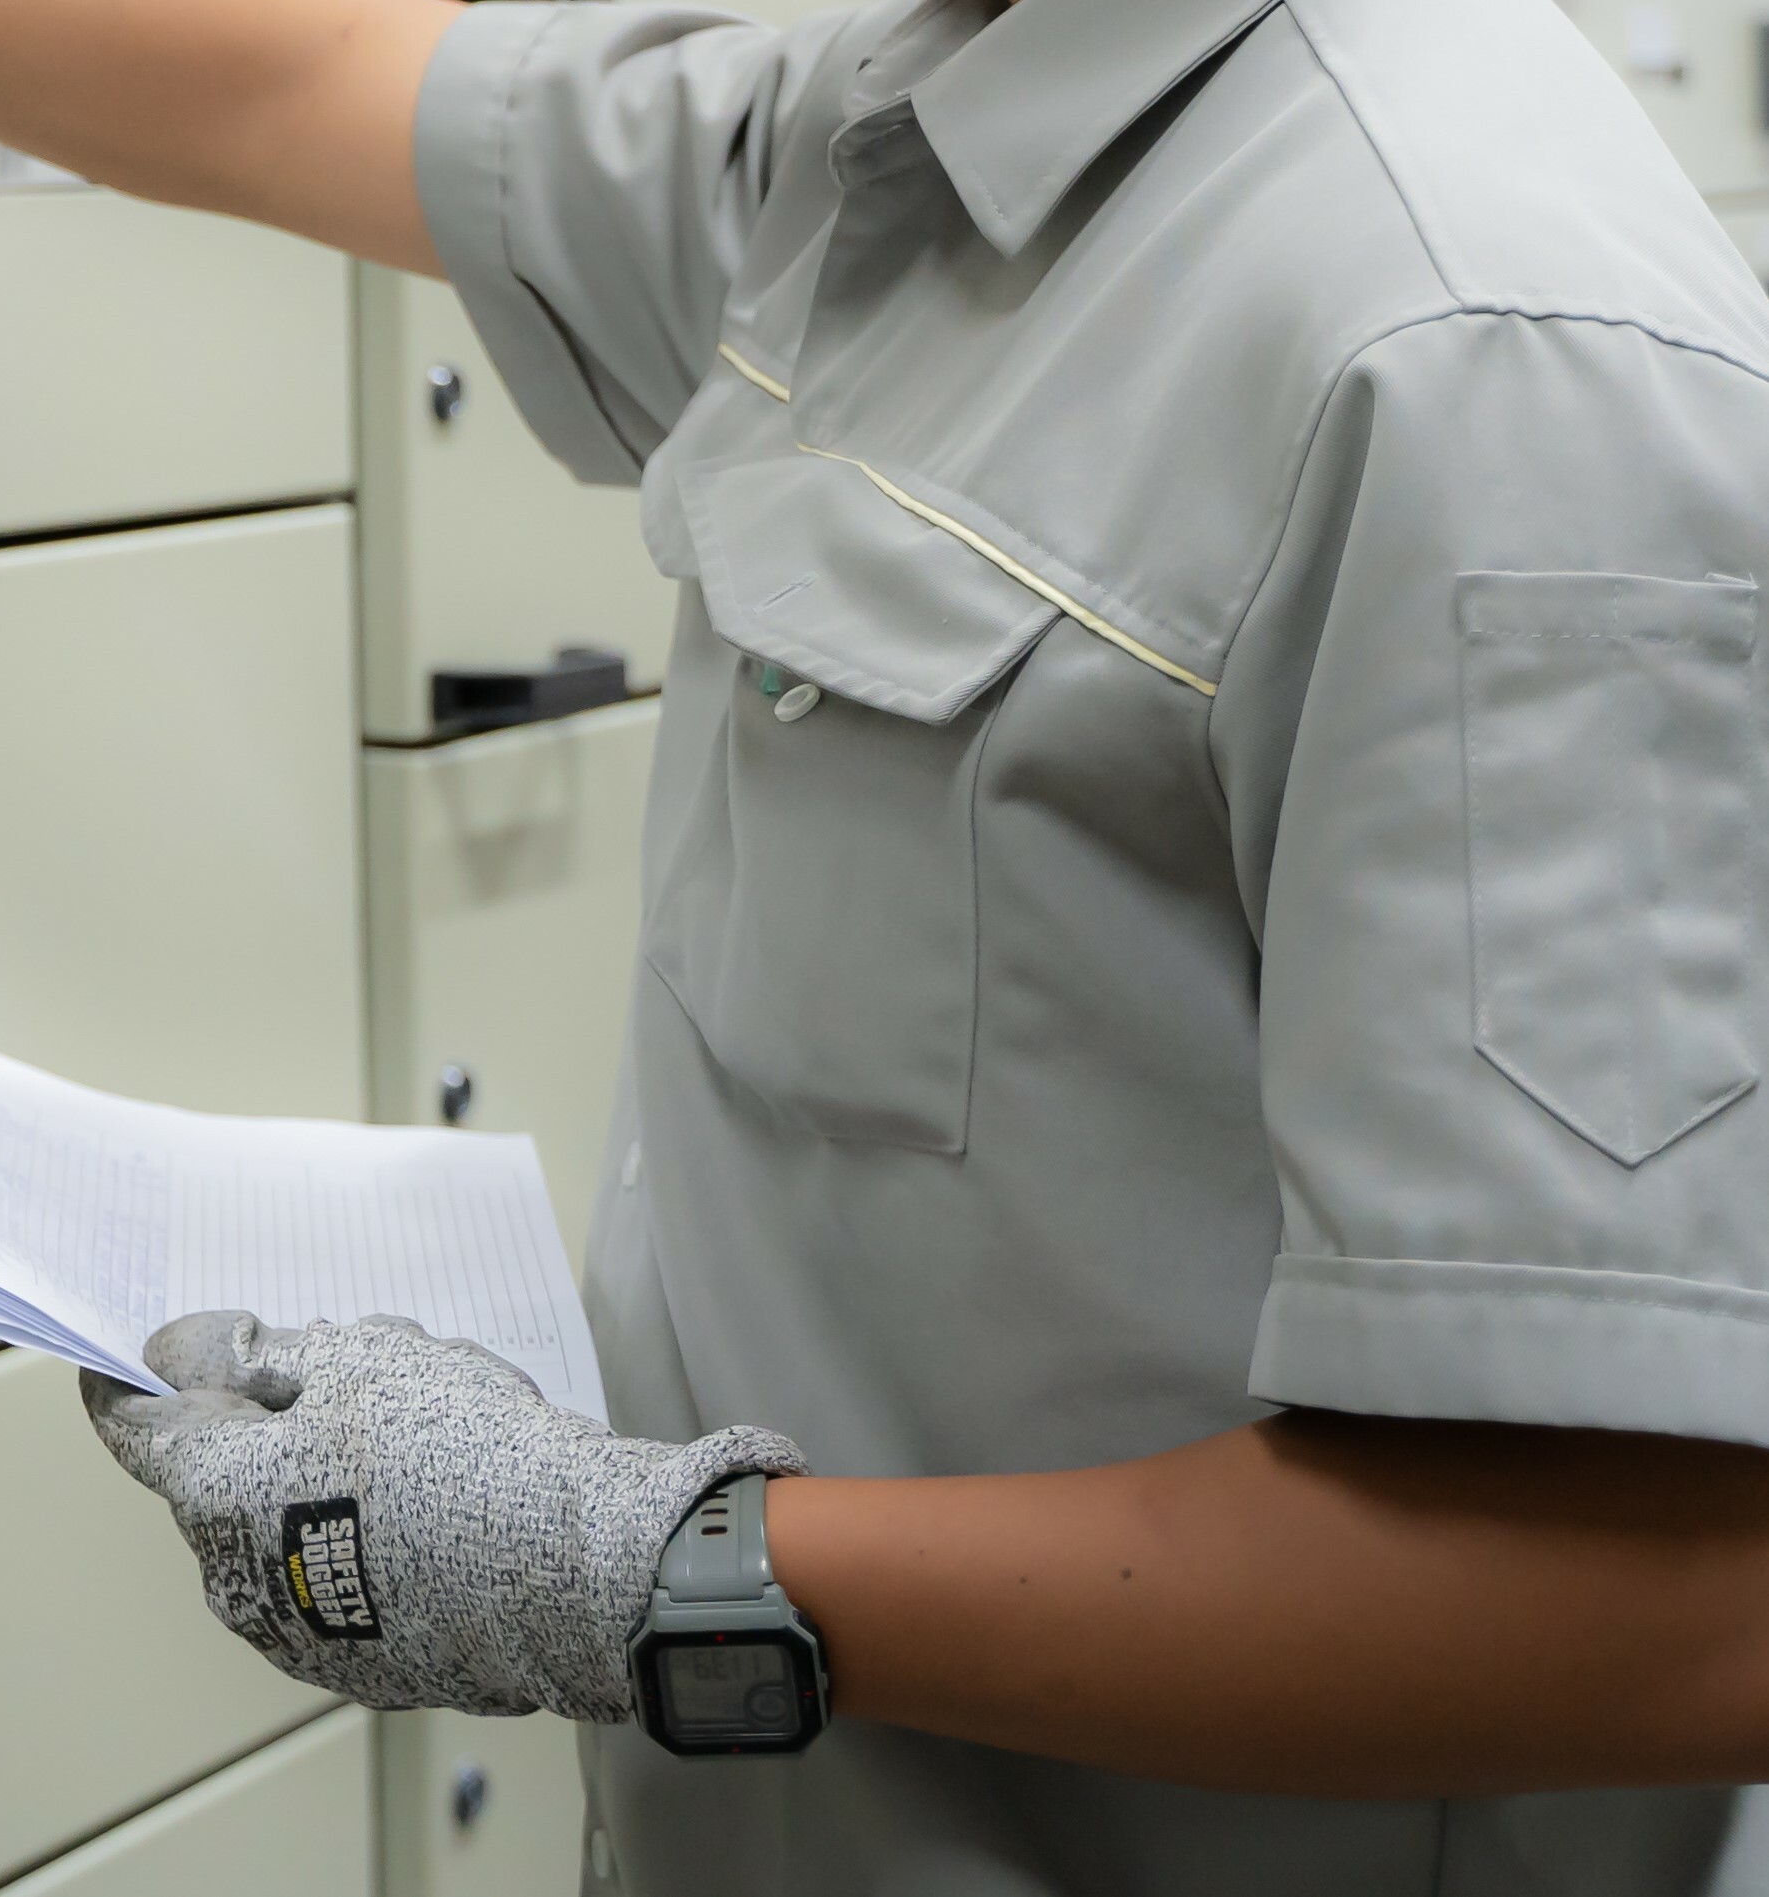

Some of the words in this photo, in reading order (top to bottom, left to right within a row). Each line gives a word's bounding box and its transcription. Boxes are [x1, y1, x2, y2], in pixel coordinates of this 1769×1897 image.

[287, 1551, 313, 1610] WORKS
[300, 1520, 347, 1627] JOGGER
[328, 1517, 374, 1627] SAFETY
